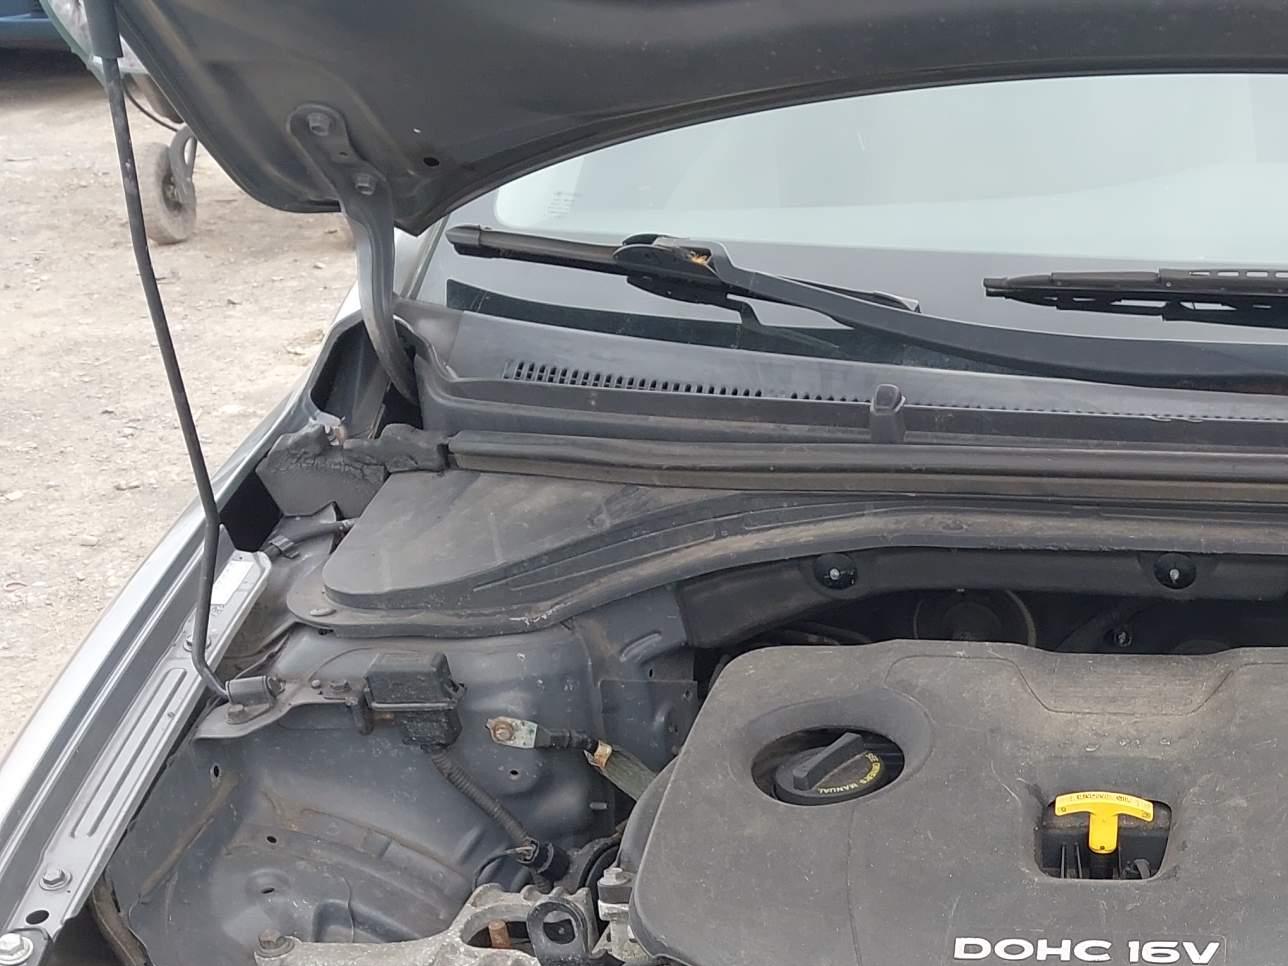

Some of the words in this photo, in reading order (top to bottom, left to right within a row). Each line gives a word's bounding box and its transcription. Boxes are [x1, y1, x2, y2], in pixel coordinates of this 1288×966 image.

[818, 783, 859, 794] MANUAL
[953, 937, 1112, 962] DOHC
[1128, 940, 1220, 964] 16V
